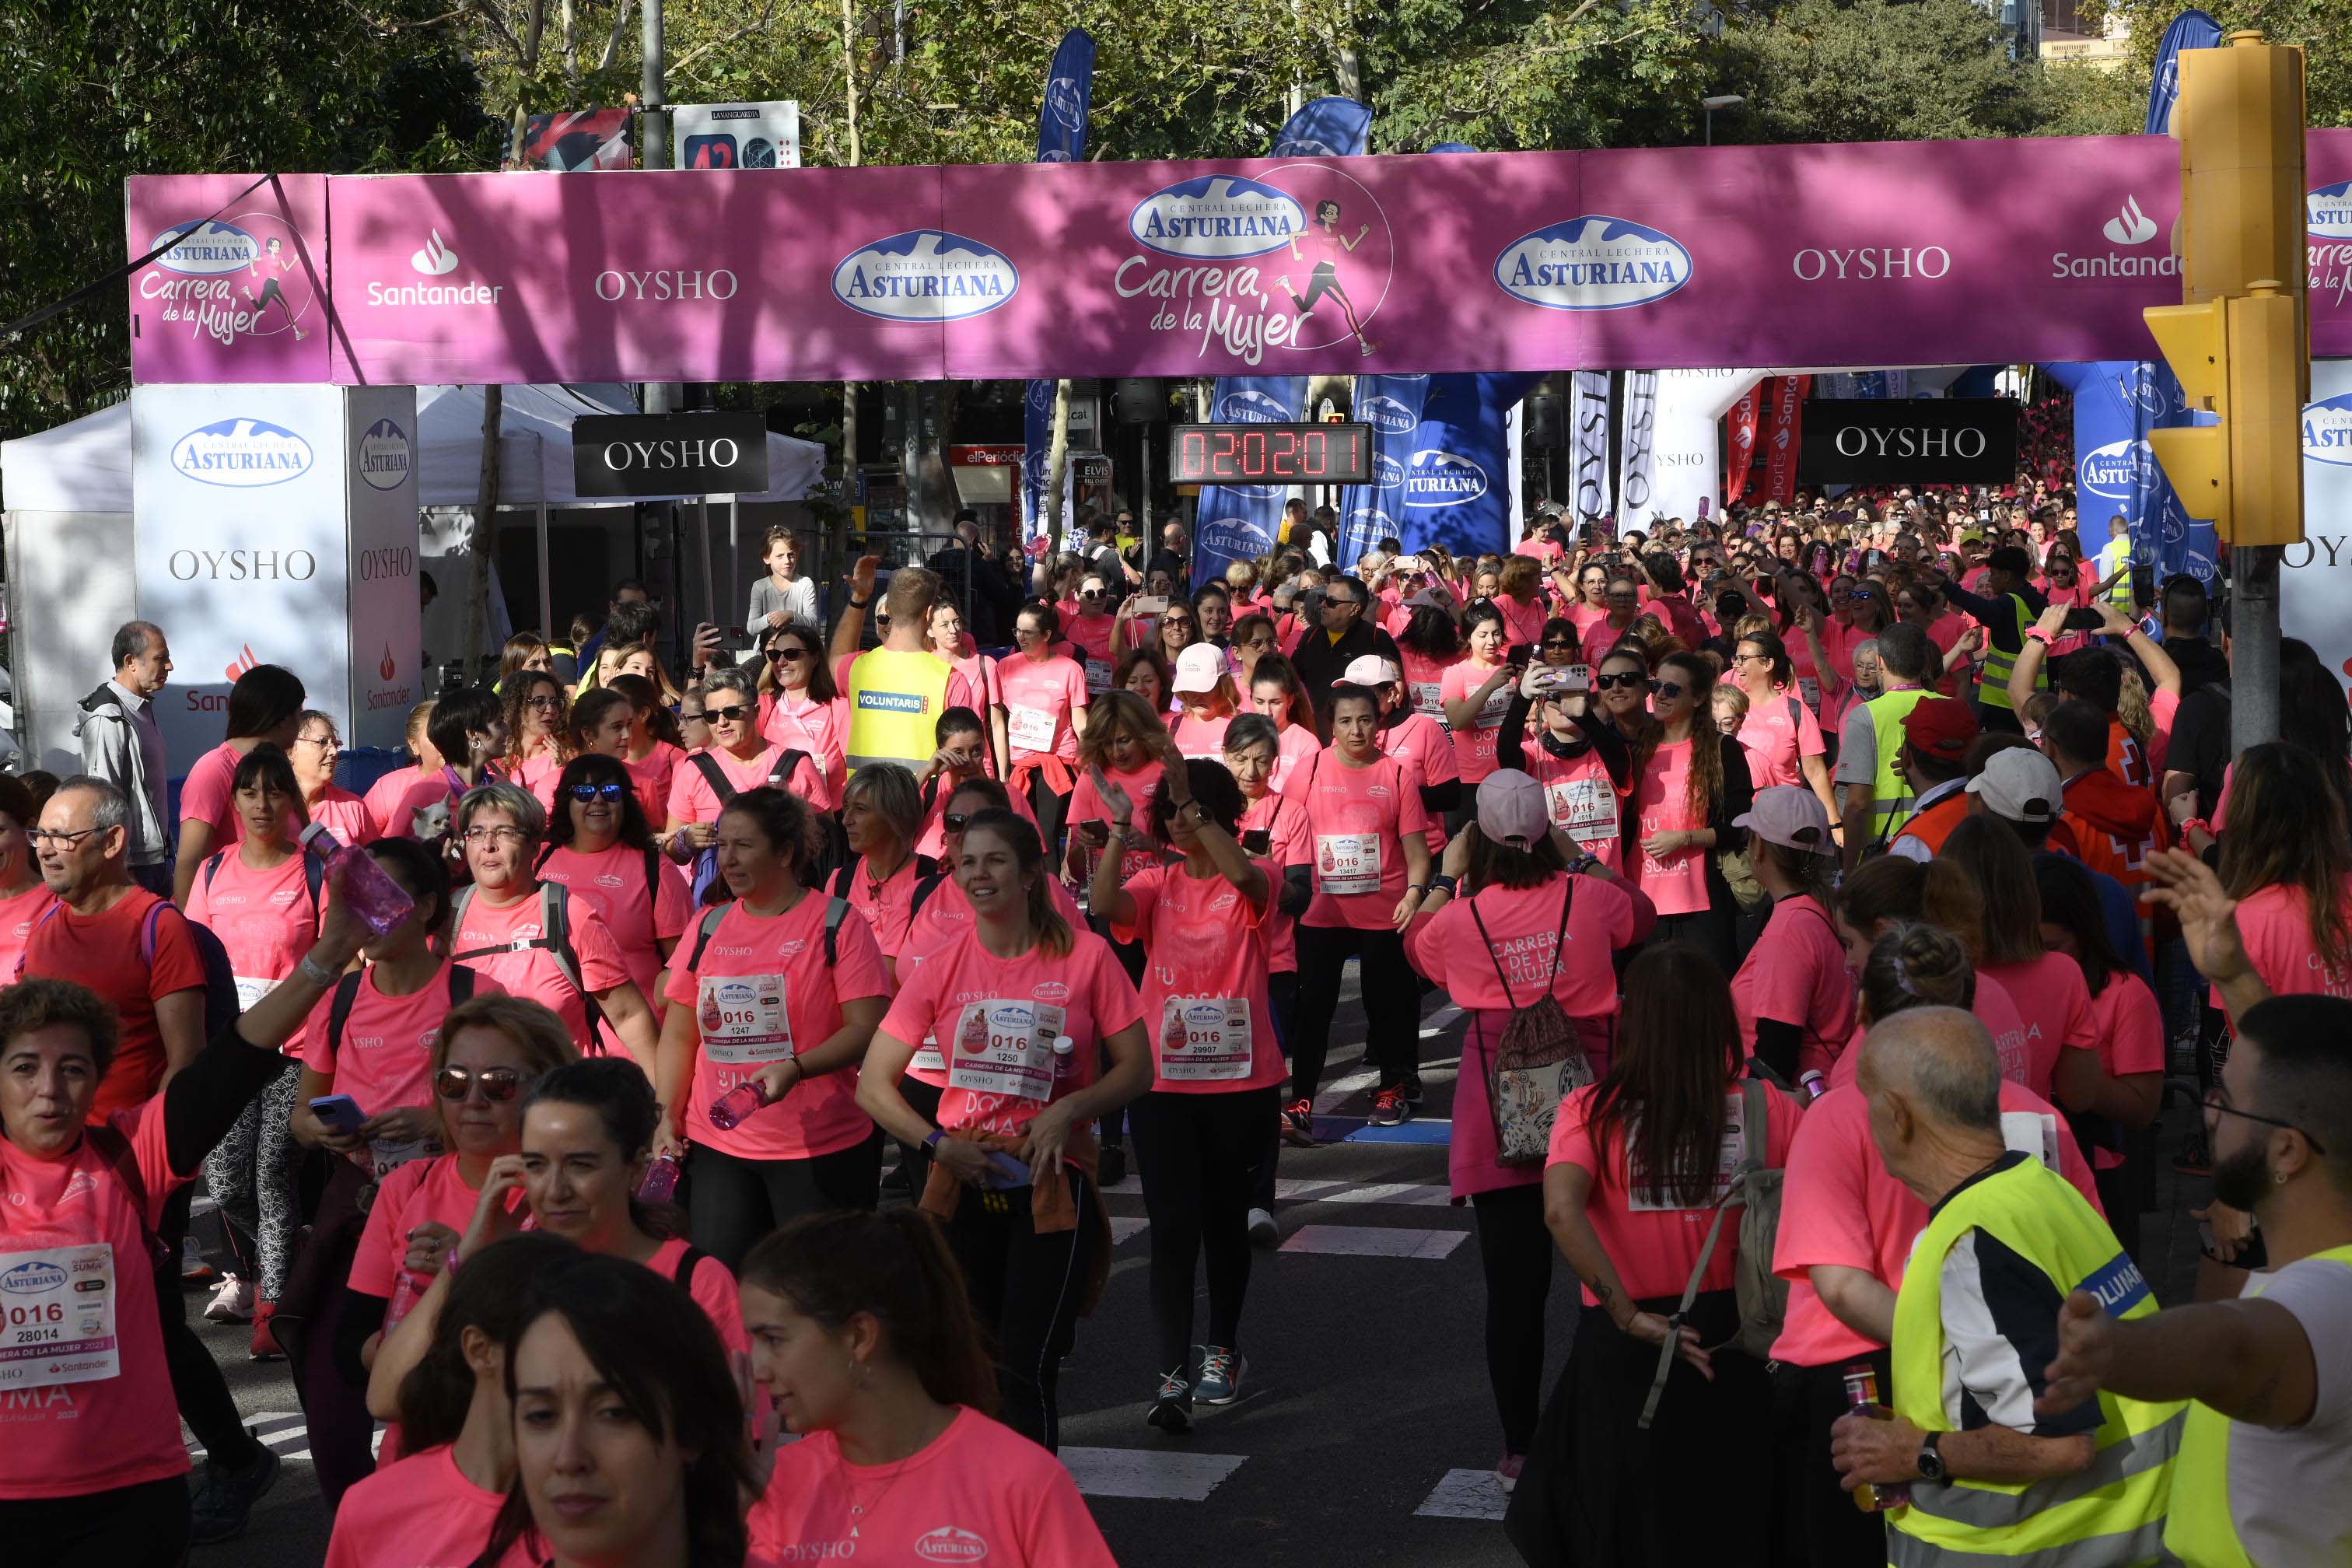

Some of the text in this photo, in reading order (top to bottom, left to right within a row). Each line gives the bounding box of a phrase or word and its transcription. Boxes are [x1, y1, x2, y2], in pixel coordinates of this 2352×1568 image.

[1170, 202, 1288, 213] CENTRAL LECHERA
[1143, 207, 1293, 238] ASTURIANA
[157, 239, 250, 261] ASTURIANA
[1540, 247, 1671, 258] CENTRAL LECHERA
[875, 261, 999, 271] CENTRAL LECHERA
[1509, 252, 1677, 286] ASTURIANA
[1793, 246, 1951, 281] OYSHO
[2053, 251, 2182, 278] Santand
[140, 271, 230, 299] Carrera
[596, 269, 738, 303] OYSHO
[846, 264, 1005, 298] ASTURIANA
[1115, 255, 1260, 299] Carrera
[2325, 267, 2339, 289] la
[368, 281, 502, 306] Santander
[162, 297, 265, 345] de la Mujer
[1150, 292, 1314, 366] de la Mujer
[1779, 376, 1798, 425] Santa
[1836, 425, 1986, 459] OYSHO
[182, 443, 303, 469] ASTURIANA
[362, 444, 408, 473] ASTURIANA
[604, 437, 739, 471] OYSHO
[1183, 432, 1356, 474] 02:02:01
[1656, 452, 1704, 466] YSHO
[1084, 466, 1108, 475] ELVIS
[1409, 478, 1480, 492] TURIANA
[1204, 530, 1269, 555] ASTURIANA
[169, 549, 316, 580] OYSHO
[360, 546, 411, 580] OYSHO
[367, 685, 411, 711] Santander
[859, 693, 922, 709] VOLUNTARIS
[1573, 803, 1595, 814] 016
[1337, 858, 1359, 866] 016
[1645, 858, 1688, 873] SUMA
[714, 946, 752, 956] OYSHO
[1508, 947, 1557, 969] DE LA
[1155, 966, 1174, 985] TU
[1510, 960, 1566, 985] MUJER
[719, 992, 754, 1000] ASTURIANA
[957, 990, 998, 1002] OYSHO
[723, 1011, 754, 1023] 016
[992, 1013, 1033, 1025] ASTURIANA
[353, 1036, 383, 1048] YSHO
[992, 1034, 1027, 1050] 016
[1189, 1031, 1220, 1042] 016
[918, 1055, 941, 1063] OYSHO
[964, 1062, 993, 1070] CARRERA
[996, 1053, 1018, 1062] 1250
[961, 1074, 992, 1085] OYSHO
[4, 1276, 62, 1289] ASTURIANA
[10, 1303, 63, 1325] 016
[17, 1328, 59, 1343] 28014
[22, 1342, 104, 1356] DE LA MUJER 2023
[62, 1360, 109, 1373] Santander
[784, 1540, 982, 1562] OYSHO ASTURIANA
